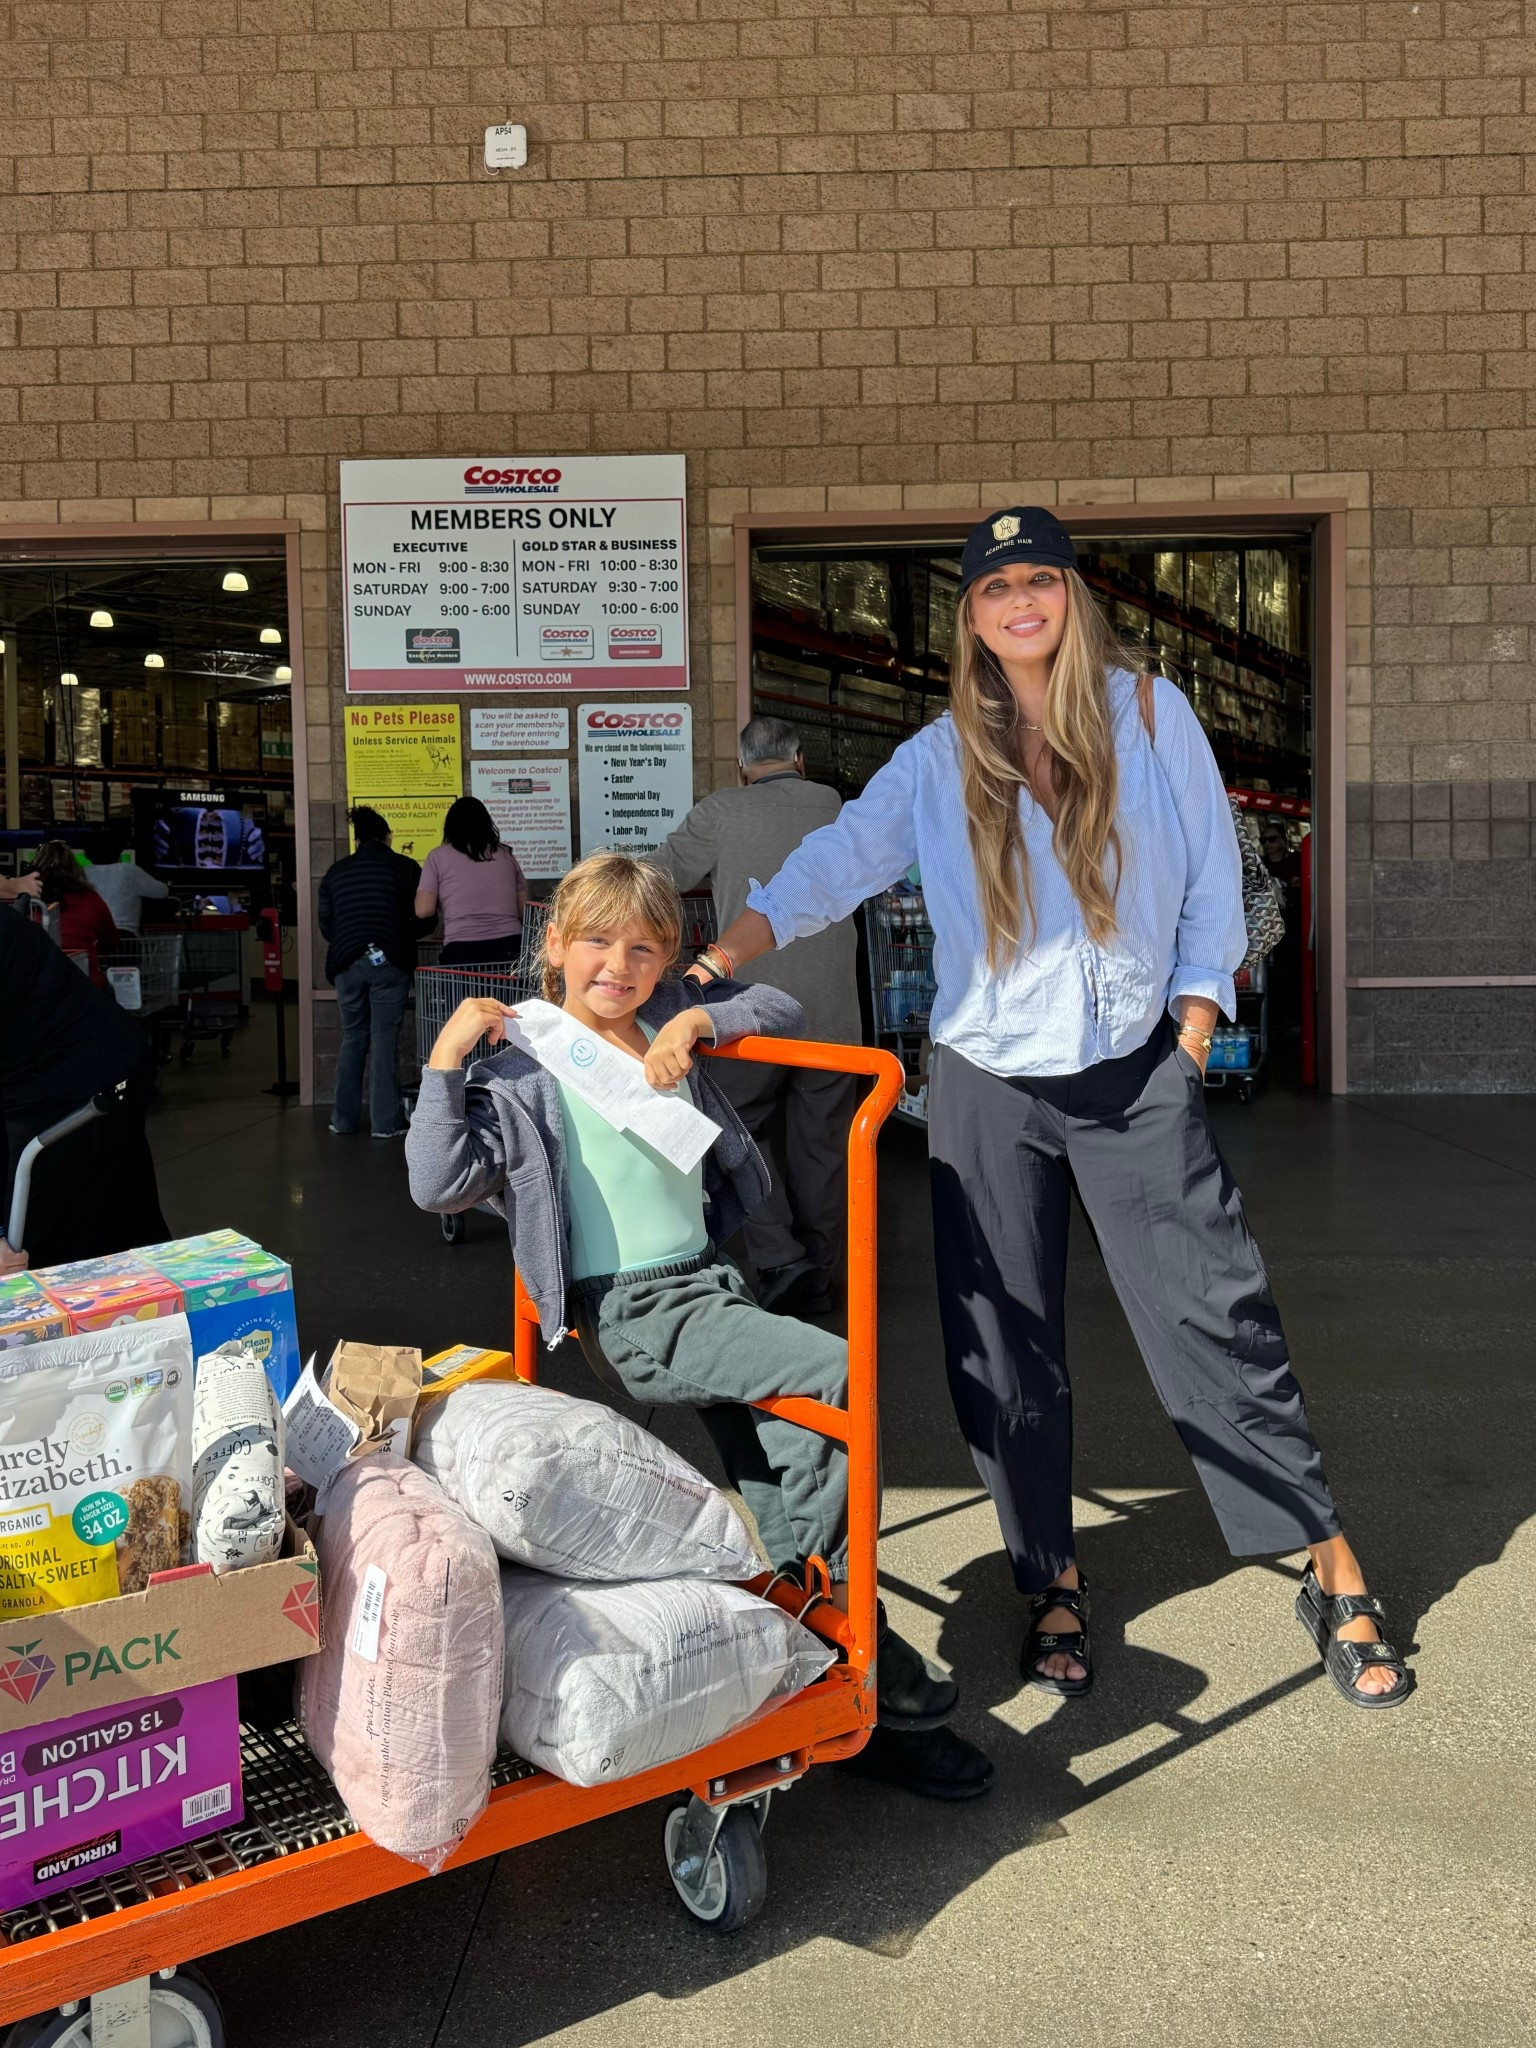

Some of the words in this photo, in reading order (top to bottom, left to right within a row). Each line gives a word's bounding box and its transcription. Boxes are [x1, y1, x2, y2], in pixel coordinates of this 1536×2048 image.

[495, 127, 512, 135] AP54
[464, 466, 562, 486] COSTCO
[411, 508, 541, 530] MEMBERS
[549, 507, 616, 528] ONLY
[393, 542, 468, 552] EXECUTIVE
[522, 541, 558, 551] GOLD
[562, 541, 596, 551] STAR
[600, 540, 608, 550] &
[612, 540, 677, 550] BUSINESS
[353, 562, 386, 573] MON
[400, 562, 420, 573] FRI
[439, 562, 468, 573] 9:00
[480, 561, 509, 572] 8:30
[522, 561, 555, 572] MON
[568, 560, 589, 571] FRI
[600, 560, 636, 571] 10:00
[649, 559, 678, 570] 8:30
[354, 583, 428, 595] SATURDAY
[440, 583, 468, 594] 9:00
[481, 583, 509, 594] 7:00
[523, 582, 597, 593] SATURDAY
[609, 582, 637, 592] 9:30
[649, 581, 678, 592] 7:00
[354, 605, 412, 616] SUNDAY
[441, 605, 469, 616] 9:00
[482, 605, 510, 616] 6:00
[523, 603, 580, 615] SUNDAY
[602, 603, 638, 614] 10:00
[650, 603, 678, 614] 6:00
[543, 629, 589, 638] COSTCO
[610, 628, 657, 637] COSTCO
[464, 672, 572, 685] WWW.COSTCO.COM
[351, 712, 368, 725] No
[374, 712, 404, 725] Pets
[409, 711, 455, 724] Please
[587, 710, 683, 729] COSTCO
[353, 737, 382, 745] Unless
[386, 736, 418, 744] Service
[421, 735, 456, 744] Animals
[639, 743, 662, 752] following
[611, 758, 627, 767] New
[629, 757, 652, 767] Year's
[654, 757, 666, 768] Day
[612, 774, 634, 784] Easter
[180, 792, 225, 802] SAMSUNG
[612, 791, 645, 801] Memorial
[648, 791, 660, 801] Day
[612, 808, 659, 818] Independence
[662, 808, 674, 818] Day
[613, 826, 632, 835] Labor
[635, 826, 647, 836] Day
[245, 1338, 270, 1348] Clean
[0, 1436, 70, 1471] urely
[205, 1439, 251, 1465] COFFEE
[0, 1453, 132, 1500] izabeth.
[620, 1460, 647, 1474] Cotton
[650, 1469, 676, 1487] Pleated
[244, 1475, 275, 1489] COFFEE
[81, 1504, 94, 1513] NOW
[80, 1510, 100, 1523] LARGER
[0, 1515, 42, 1532] RGANIC
[82, 1520, 103, 1540] 34
[104, 1508, 125, 1529] OZ
[2, 1596, 45, 1608] GRANOLA
[685, 1646, 709, 1660] Cotton
[710, 1636, 733, 1650] Pleated
[65, 1628, 183, 1686] PACK
[383, 1660, 394, 1698] Pleated
[140, 1710, 164, 1731] 13
[382, 1701, 391, 1735] Cotton
[42, 1721, 133, 1766] GALLON
[0, 1735, 187, 1840] KITCHE
[36, 1840, 117, 1880] KIRKLAND
